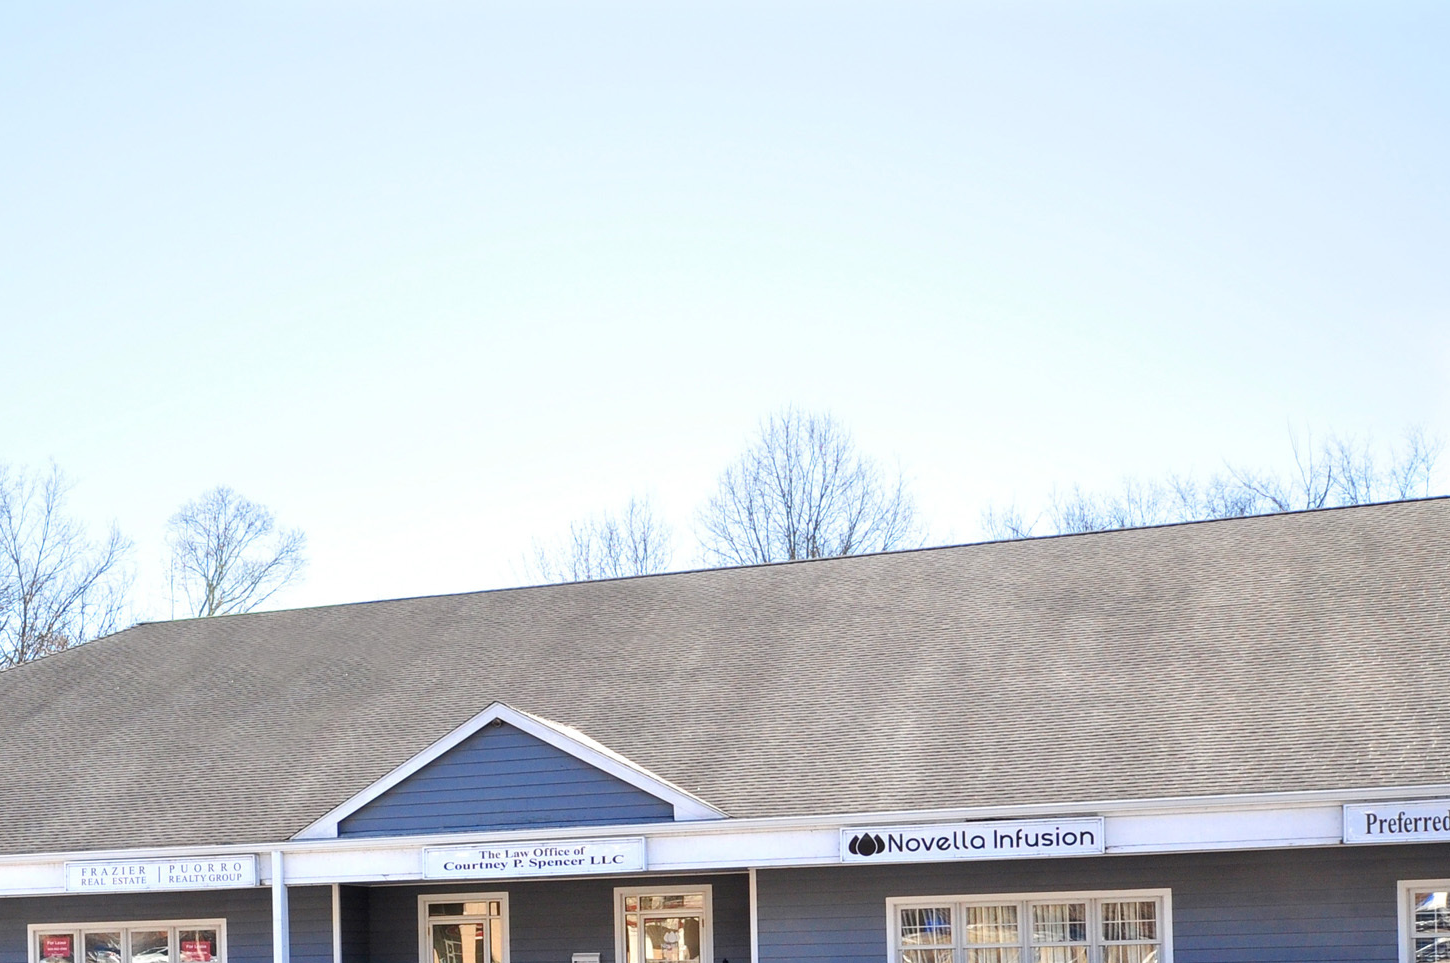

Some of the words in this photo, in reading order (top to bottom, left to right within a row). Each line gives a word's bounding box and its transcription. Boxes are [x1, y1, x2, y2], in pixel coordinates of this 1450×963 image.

[888, 831, 986, 853] Novella
[993, 827, 1095, 849] Infusion
[479, 850, 501, 860] The
[505, 849, 530, 859] Law
[533, 847, 570, 858] Office
[573, 846, 586, 856] of
[169, 862, 242, 874] PUORRO
[443, 861, 509, 871] Courtney
[513, 859, 524, 868] P.
[528, 858, 586, 869] Spencer
[590, 854, 625, 865] LLC
[81, 866, 146, 877] FRAZIER
[81, 877, 106, 886] REAL
[112, 876, 147, 885] ESTATE
[169, 874, 207, 883] REALTY
[208, 873, 243, 882] GROUP
